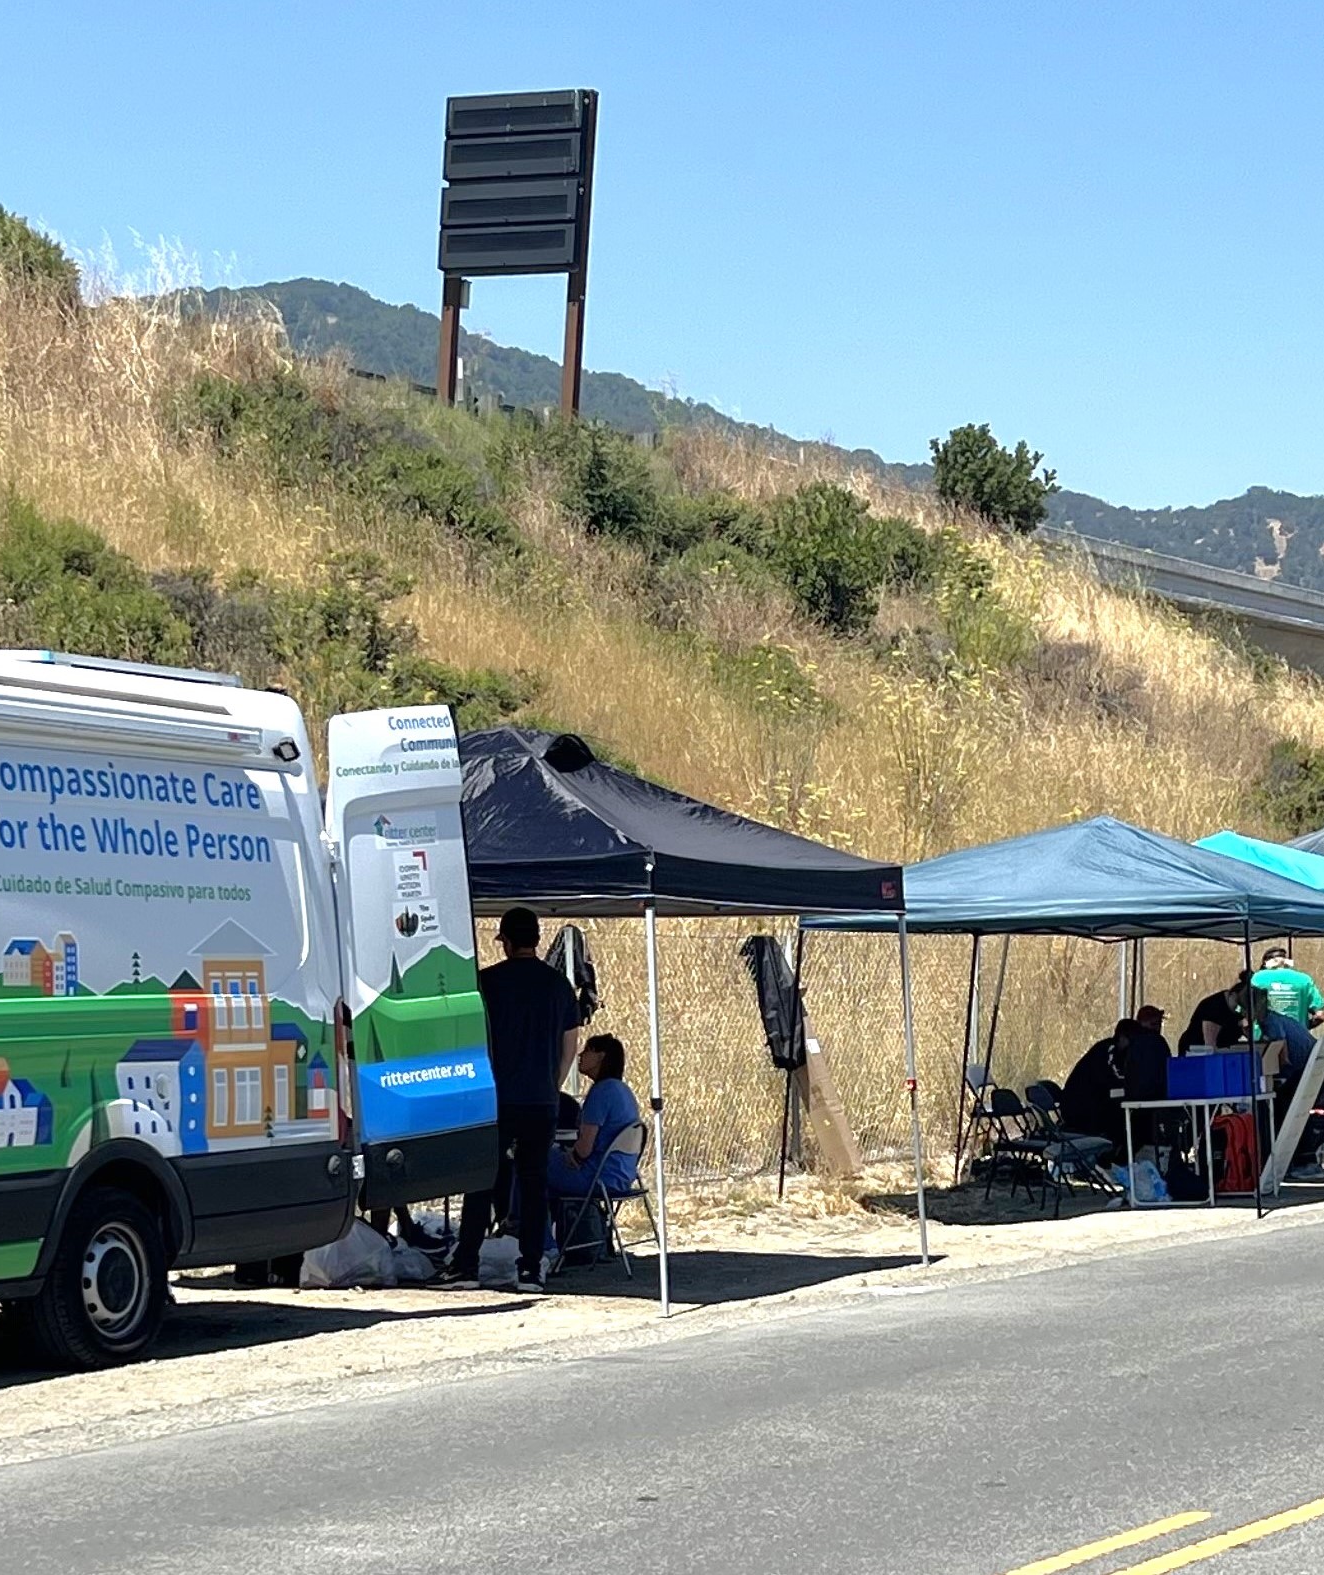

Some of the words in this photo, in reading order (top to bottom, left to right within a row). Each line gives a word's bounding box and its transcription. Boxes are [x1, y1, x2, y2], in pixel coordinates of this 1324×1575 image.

[388, 714, 451, 731] Connected
[336, 761, 392, 777] Conectando
[391, 763, 399, 776] y
[401, 759, 439, 772] Cuidando
[440, 758, 451, 769] de
[203, 773, 261, 810] Care
[36, 812, 86, 853] the
[91, 817, 179, 858] Whole
[186, 824, 272, 863] Person
[54, 876, 72, 896] de
[75, 877, 112, 897] Salud
[115, 879, 185, 903] Compasivo
[187, 884, 215, 903] para
[218, 883, 252, 902] todos
[380, 1062, 477, 1088] rittercenter.org
